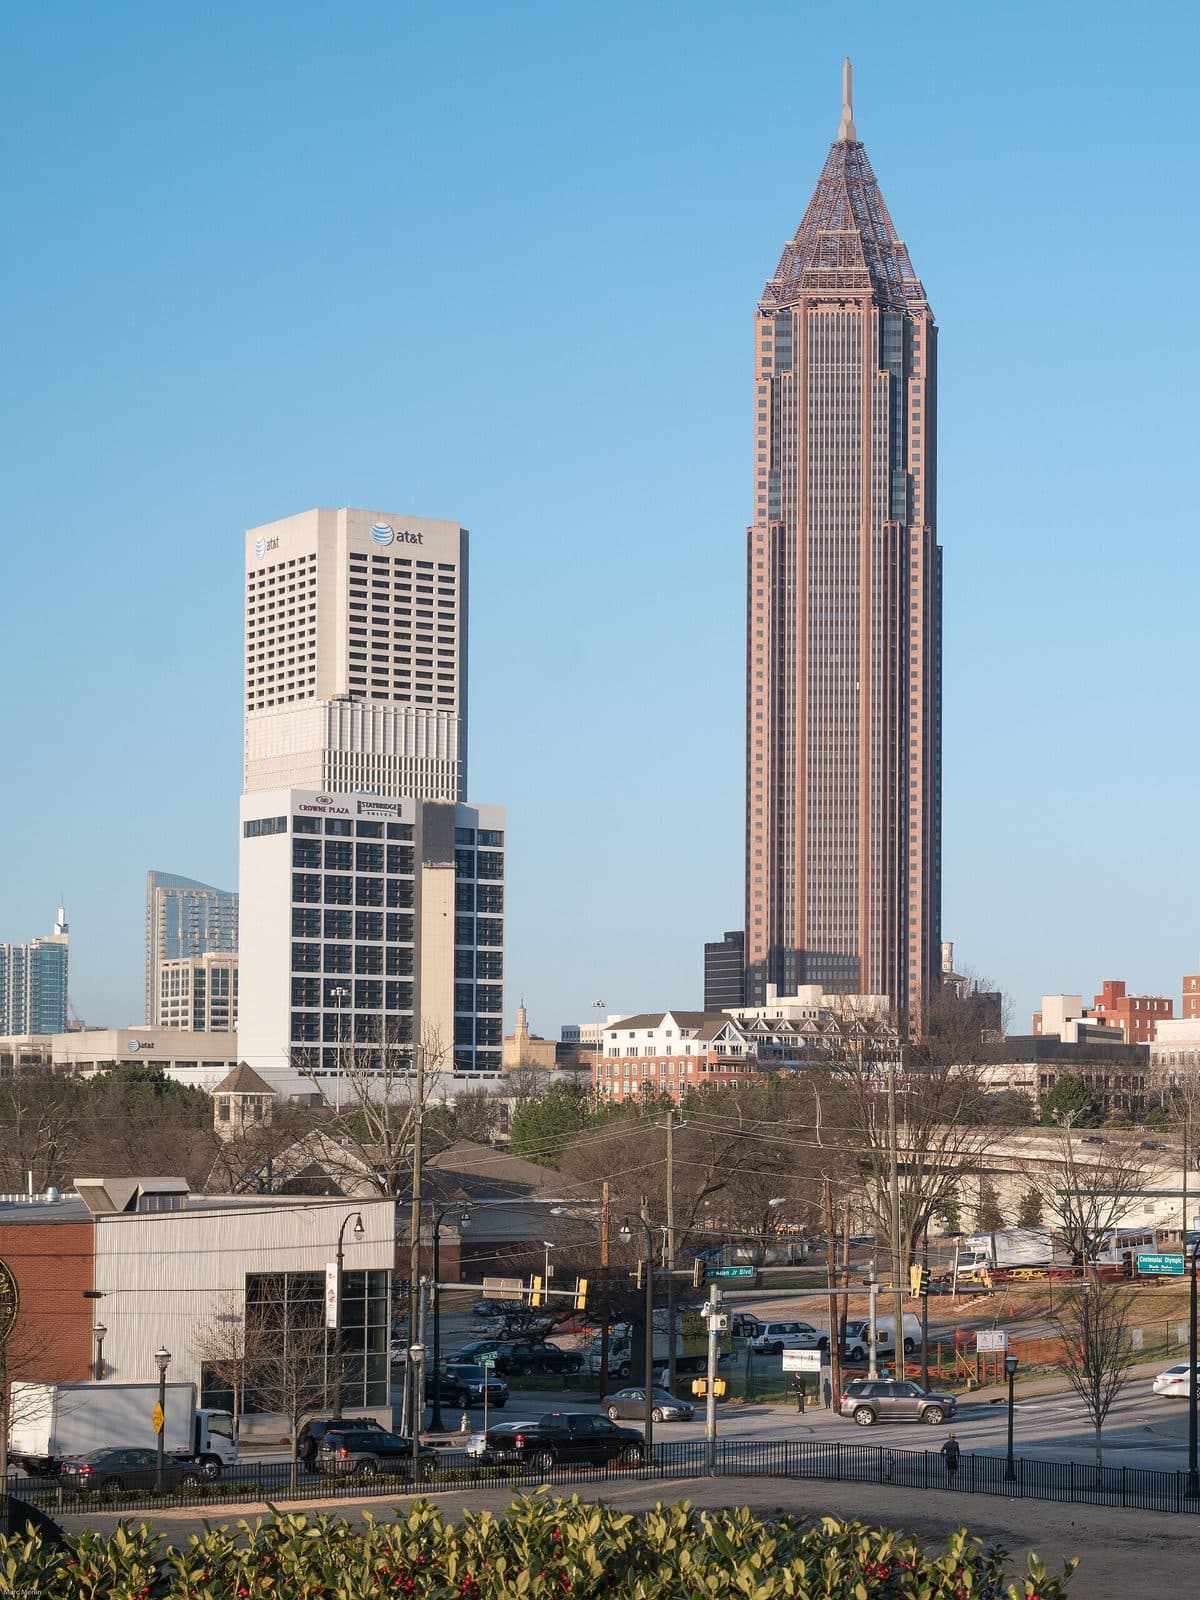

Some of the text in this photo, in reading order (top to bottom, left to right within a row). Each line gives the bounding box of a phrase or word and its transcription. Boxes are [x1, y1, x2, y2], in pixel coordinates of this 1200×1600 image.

[266, 536, 280, 550] at&t
[396, 530, 424, 545] at&t
[299, 804, 327, 813] CROWNE
[361, 801, 396, 810] STAYBRIDGE
